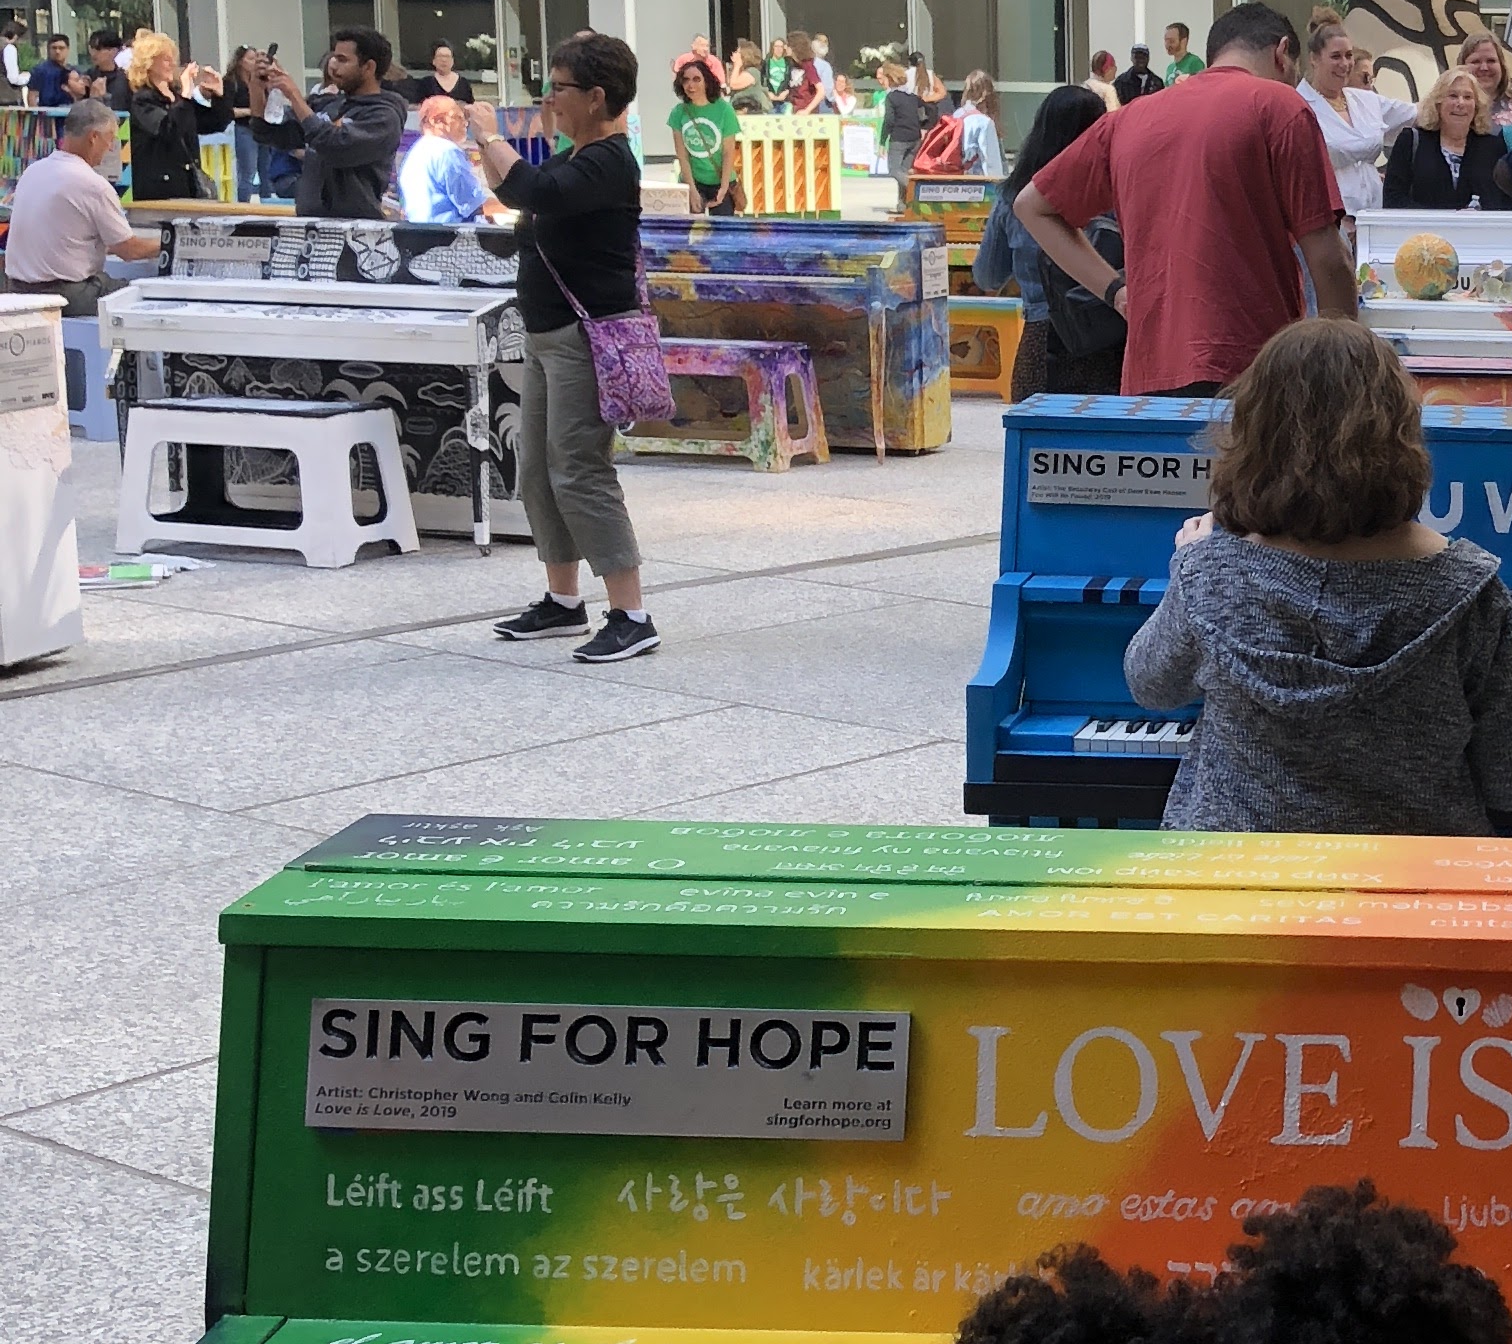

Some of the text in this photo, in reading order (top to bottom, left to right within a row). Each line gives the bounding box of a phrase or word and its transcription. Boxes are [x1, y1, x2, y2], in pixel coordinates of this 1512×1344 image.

[921, 185, 984, 194] SING FOR HOPE
[180, 237, 270, 249] SING FOR HOPE
[1033, 452, 1106, 476] SING
[1117, 456, 1181, 479] FOR
[318, 1007, 898, 1072] SING FOR HOPE
[315, 1085, 632, 1108] Artist: Christopher Wong and Colin Kelly
[963, 1025, 1353, 1146] LOVE
[314, 1102, 458, 1119] Love is Love, 2019
[783, 1096, 892, 1112] Learn more at
[765, 1112, 892, 1131] singforhope.org
[325, 1172, 553, 1214] Léift ass Léift
[615, 1171, 952, 1227] 사랑은 사랑이다
[1017, 1188, 1300, 1222] amo estas am
[325, 1240, 748, 1284] a szerelem az szerelem
[803, 1257, 1015, 1296] kärlek är kär
